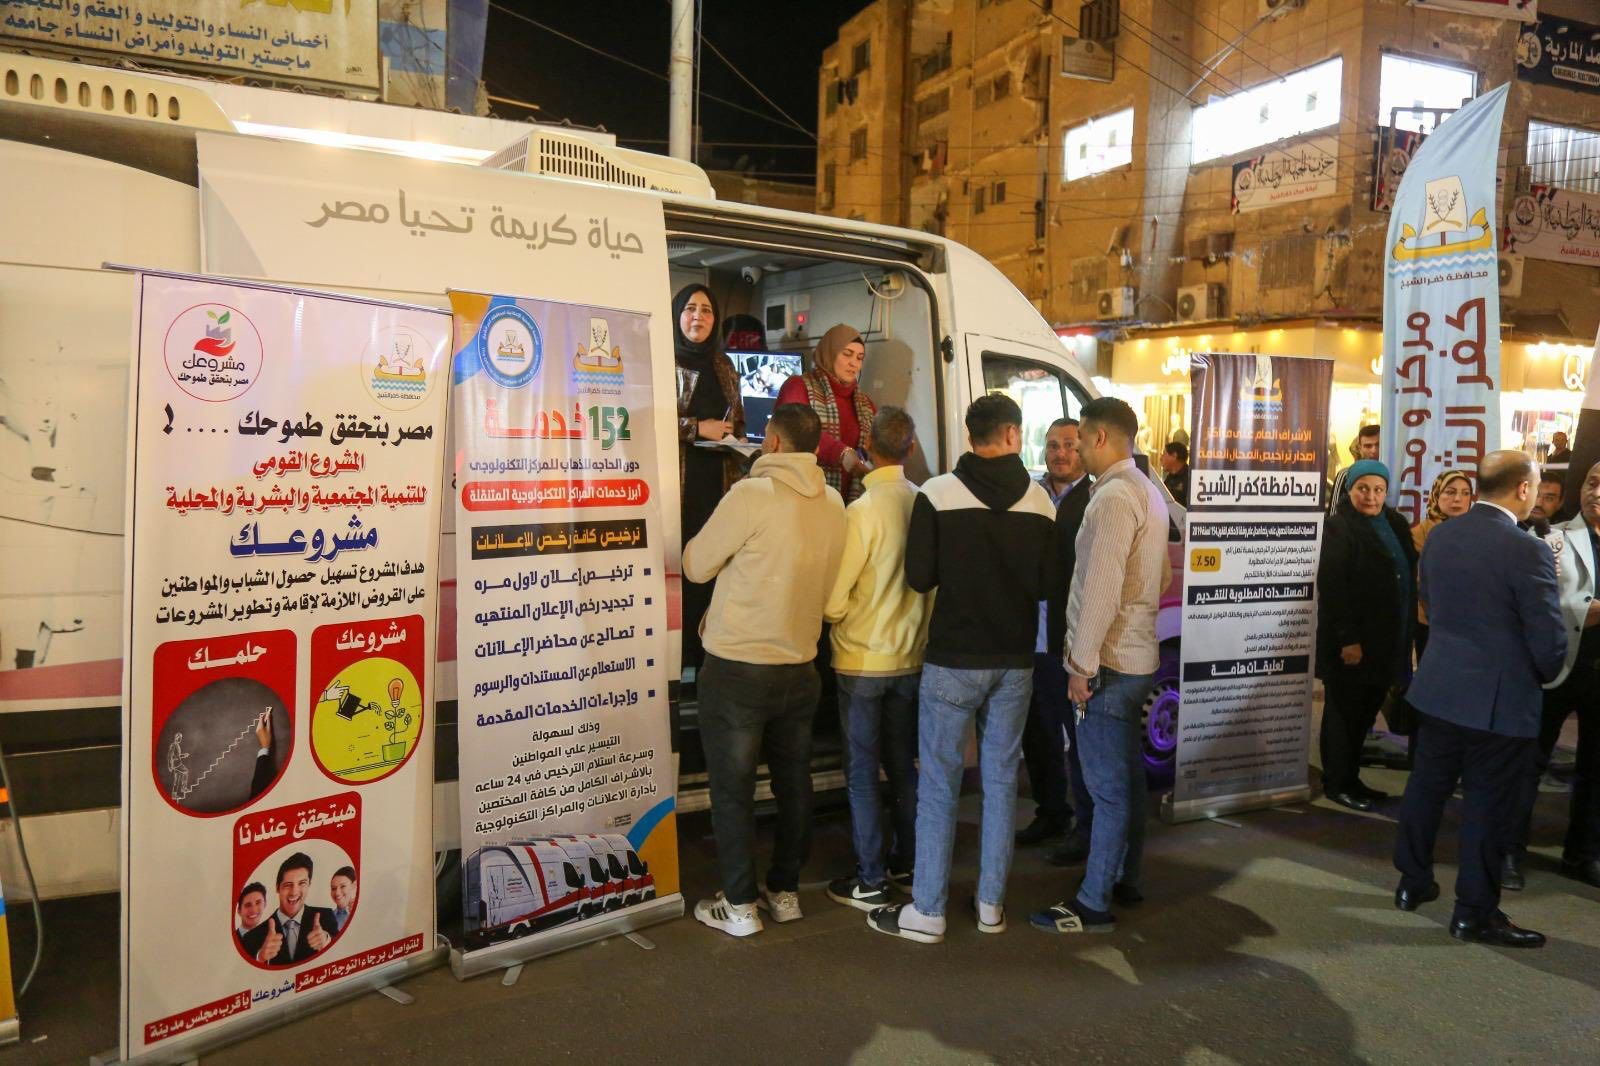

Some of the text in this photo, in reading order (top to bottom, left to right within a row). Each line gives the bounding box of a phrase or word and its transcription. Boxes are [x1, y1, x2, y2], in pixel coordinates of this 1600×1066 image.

[85, 0, 129, 19] العقم
[65, 22, 120, 42] النساء
[148, 12, 215, 37] والتوليد
[219, 22, 268, 40] النساء
[124, 32, 185, 56] وأمراض
[189, 43, 245, 61] التوليد
[250, 50, 311, 71] ماجستير
[304, 187, 644, 259] حياة كريمة تحيا مصر
[1446, 271, 1488, 282] محافظة
[1396, 311, 1434, 398] مركز
[1440, 297, 1494, 390] كفر
[182, 352, 245, 373] مشروعك
[177, 372, 249, 388] مصر بتحقق طموحك
[238, 410, 323, 444] طموحك
[330, 413, 390, 447] بتحقق
[391, 420, 434, 447] مصر
[485, 399, 631, 450] 152 خدمة
[252, 449, 365, 480] المشروع القومي
[469, 458, 640, 474] دون الحاجه للذهاب للمركز التكنولوجى
[1292, 450, 1316, 465] اصدار
[165, 483, 427, 516] للتنمية المجتمعية والبشرية والمحلية
[469, 485, 642, 504] أبرز خدمات المراكز التكنولوجية المتنقلة
[1197, 474, 1317, 502] بمحافظة كفر الشيخ
[229, 514, 379, 562] مشروعك
[476, 527, 641, 551] ترخيص كافة رخص للإعلانات
[1204, 556, 1216, 566] 50
[161, 560, 425, 598] هدف المشروع تسهيل حصول الشباب والمواطنين
[474, 564, 633, 594] ترخيص إعلان لاول مره
[155, 585, 426, 626] على القروض اللازمة لإقامة وتطوير المشروعات
[1195, 585, 1308, 604] المستندات المطلوبة للتقديم
[474, 595, 634, 626] تجديد رخص الإعلان المنتهيه
[335, 620, 407, 653] مشروعك
[474, 626, 635, 658] تصالح عن محاضر الإعلانات
[187, 640, 268, 671] حلمك
[1211, 661, 1246, 677] هامة
[474, 657, 636, 697] الاستعلام عن المستندات والرسوم
[476, 689, 638, 728] وإجراءات الخدمات المقدمة
[532, 721, 601, 742] وذلك لسهولة
[511, 735, 621, 768] التيسير علي المواطنين
[475, 749, 655, 793] وسرعة استلام الترخيص في 24 ساعه
[478, 767, 653, 814] بالاشراف الكامل من كافة المختصين
[238, 801, 357, 846] هيتحقق عندنا
[475, 785, 657, 835] بأدارة الاعلانات والمراكز التكنولوجية
[388, 939, 420, 959] للتواصل
[296, 974, 314, 991] مقر
[316, 967, 332, 984] الى
[252, 979, 296, 1003] مشروعك
[150, 1019, 184, 1038] مدينة
[186, 1008, 218, 1029] مجلس
